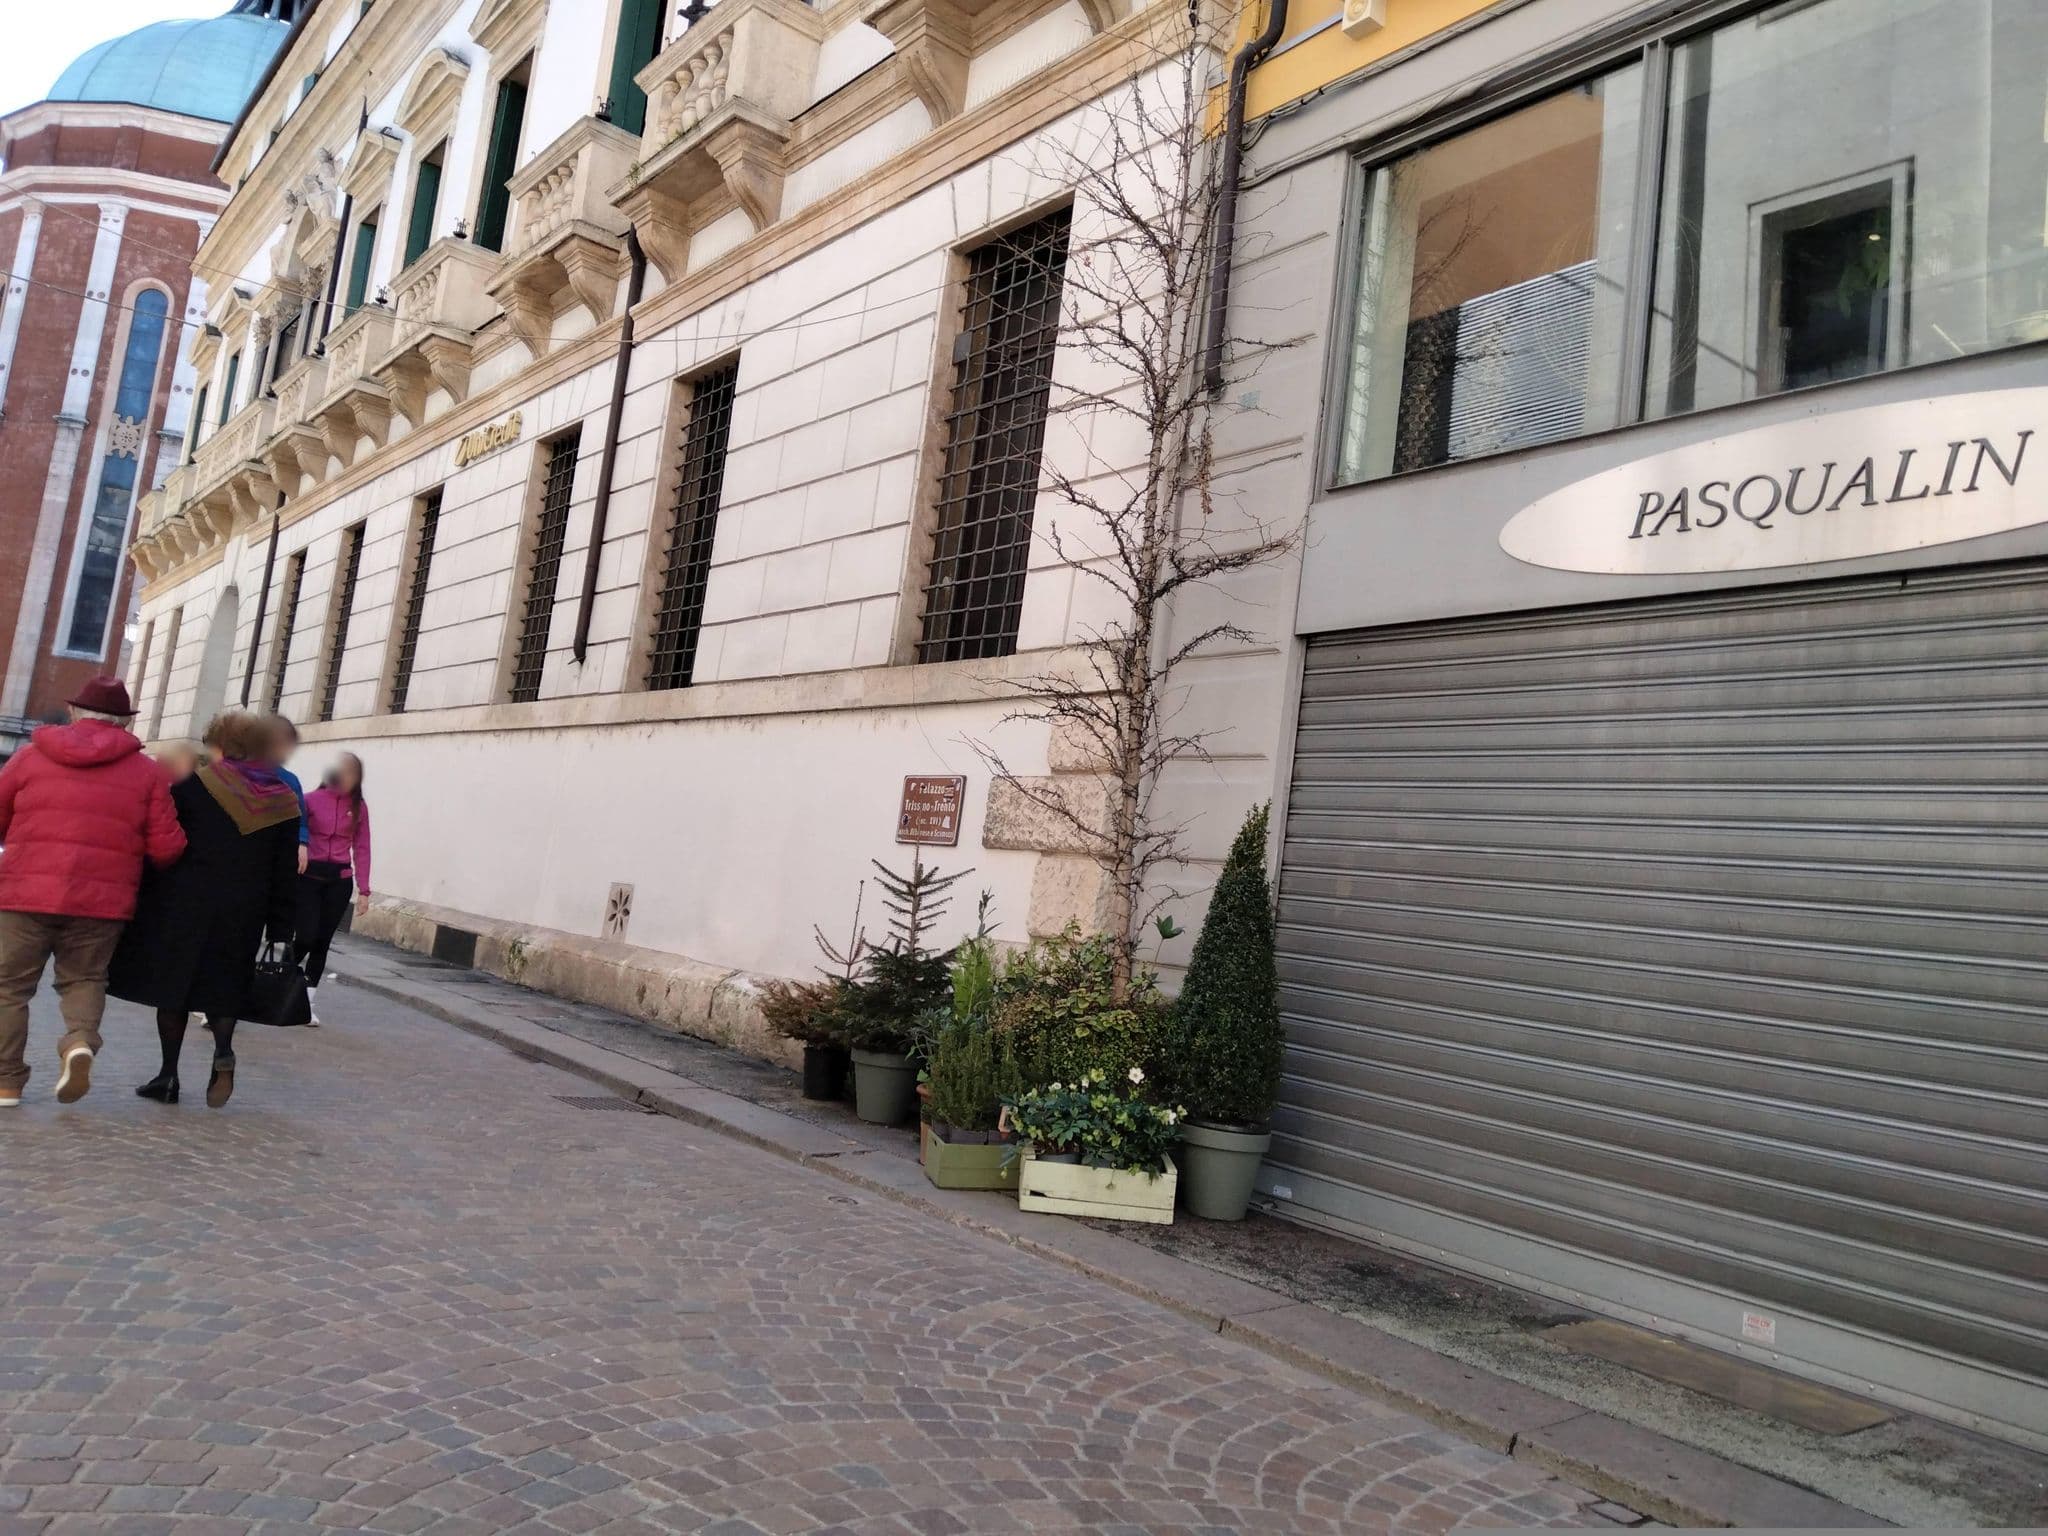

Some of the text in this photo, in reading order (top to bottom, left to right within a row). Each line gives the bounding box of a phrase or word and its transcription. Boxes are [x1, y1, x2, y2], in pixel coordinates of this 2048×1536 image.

[1628, 430, 2035, 539] PASQUALIN
[919, 782, 945, 794] Palazzo
[905, 799, 956, 812] Trissno-Trento
